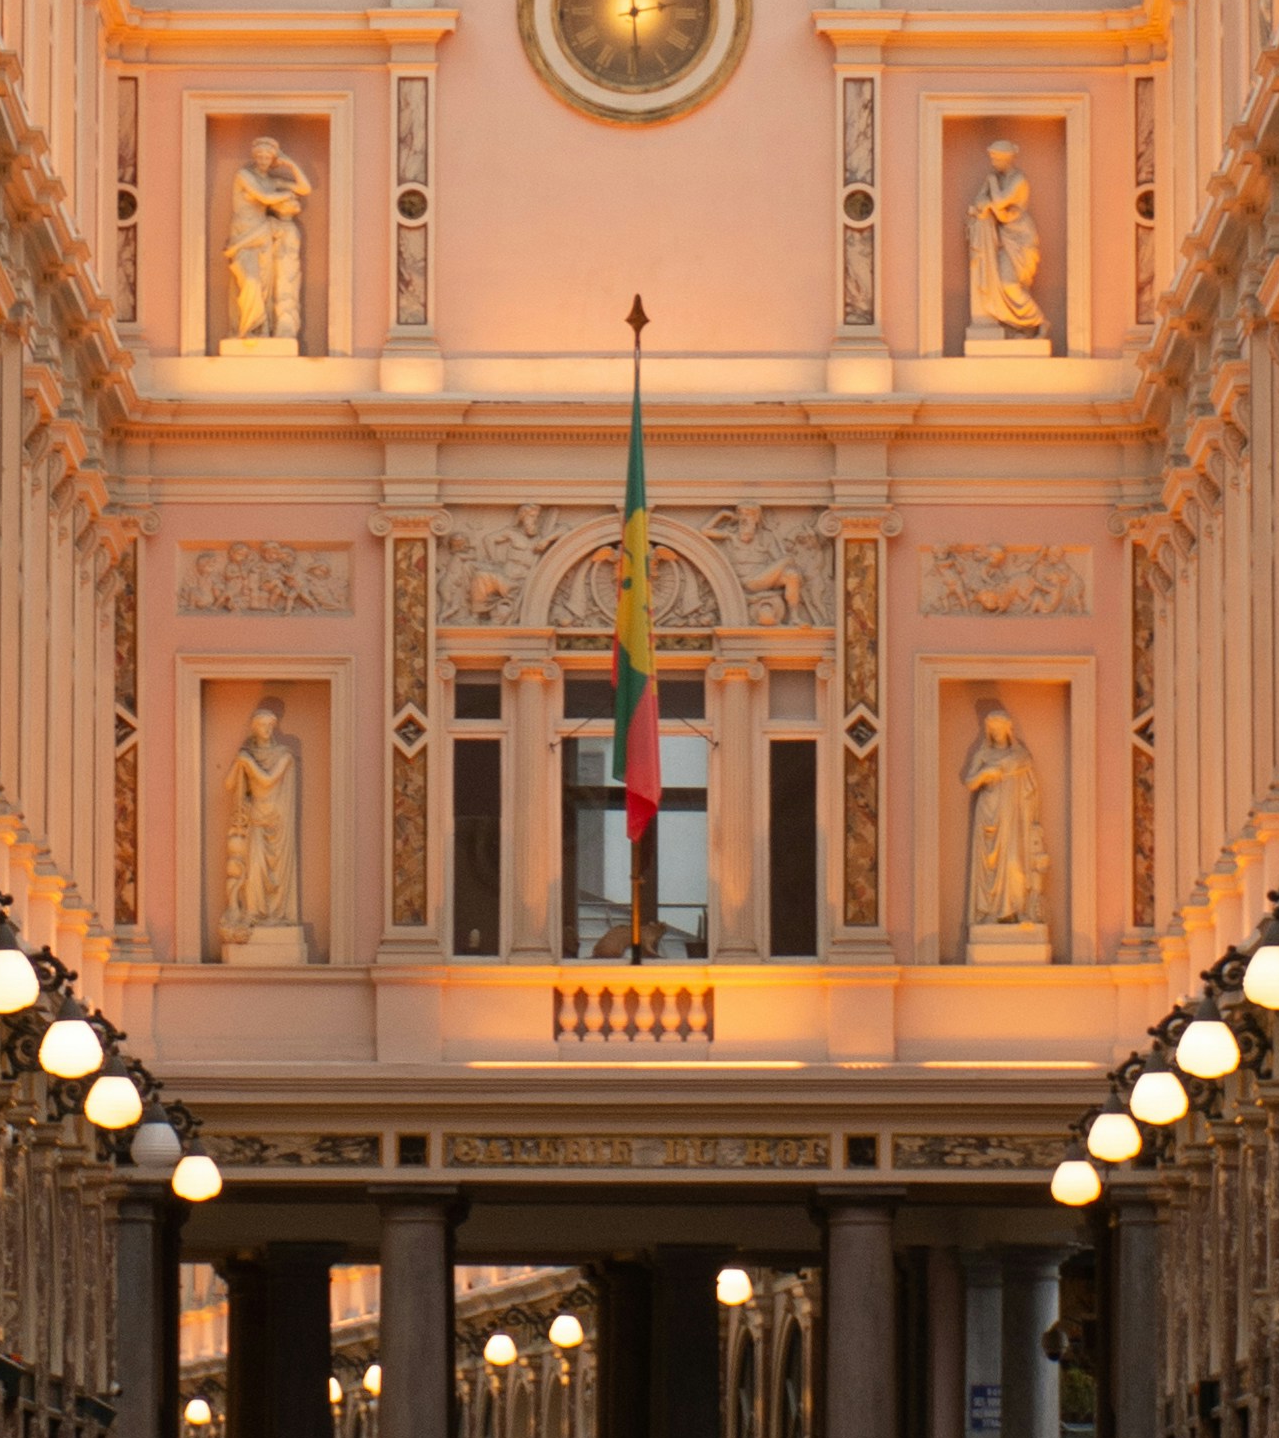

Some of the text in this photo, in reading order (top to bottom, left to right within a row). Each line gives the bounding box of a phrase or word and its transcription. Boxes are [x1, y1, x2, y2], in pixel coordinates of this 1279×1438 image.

[453, 1137, 829, 1166] GALERIE DU ROI
